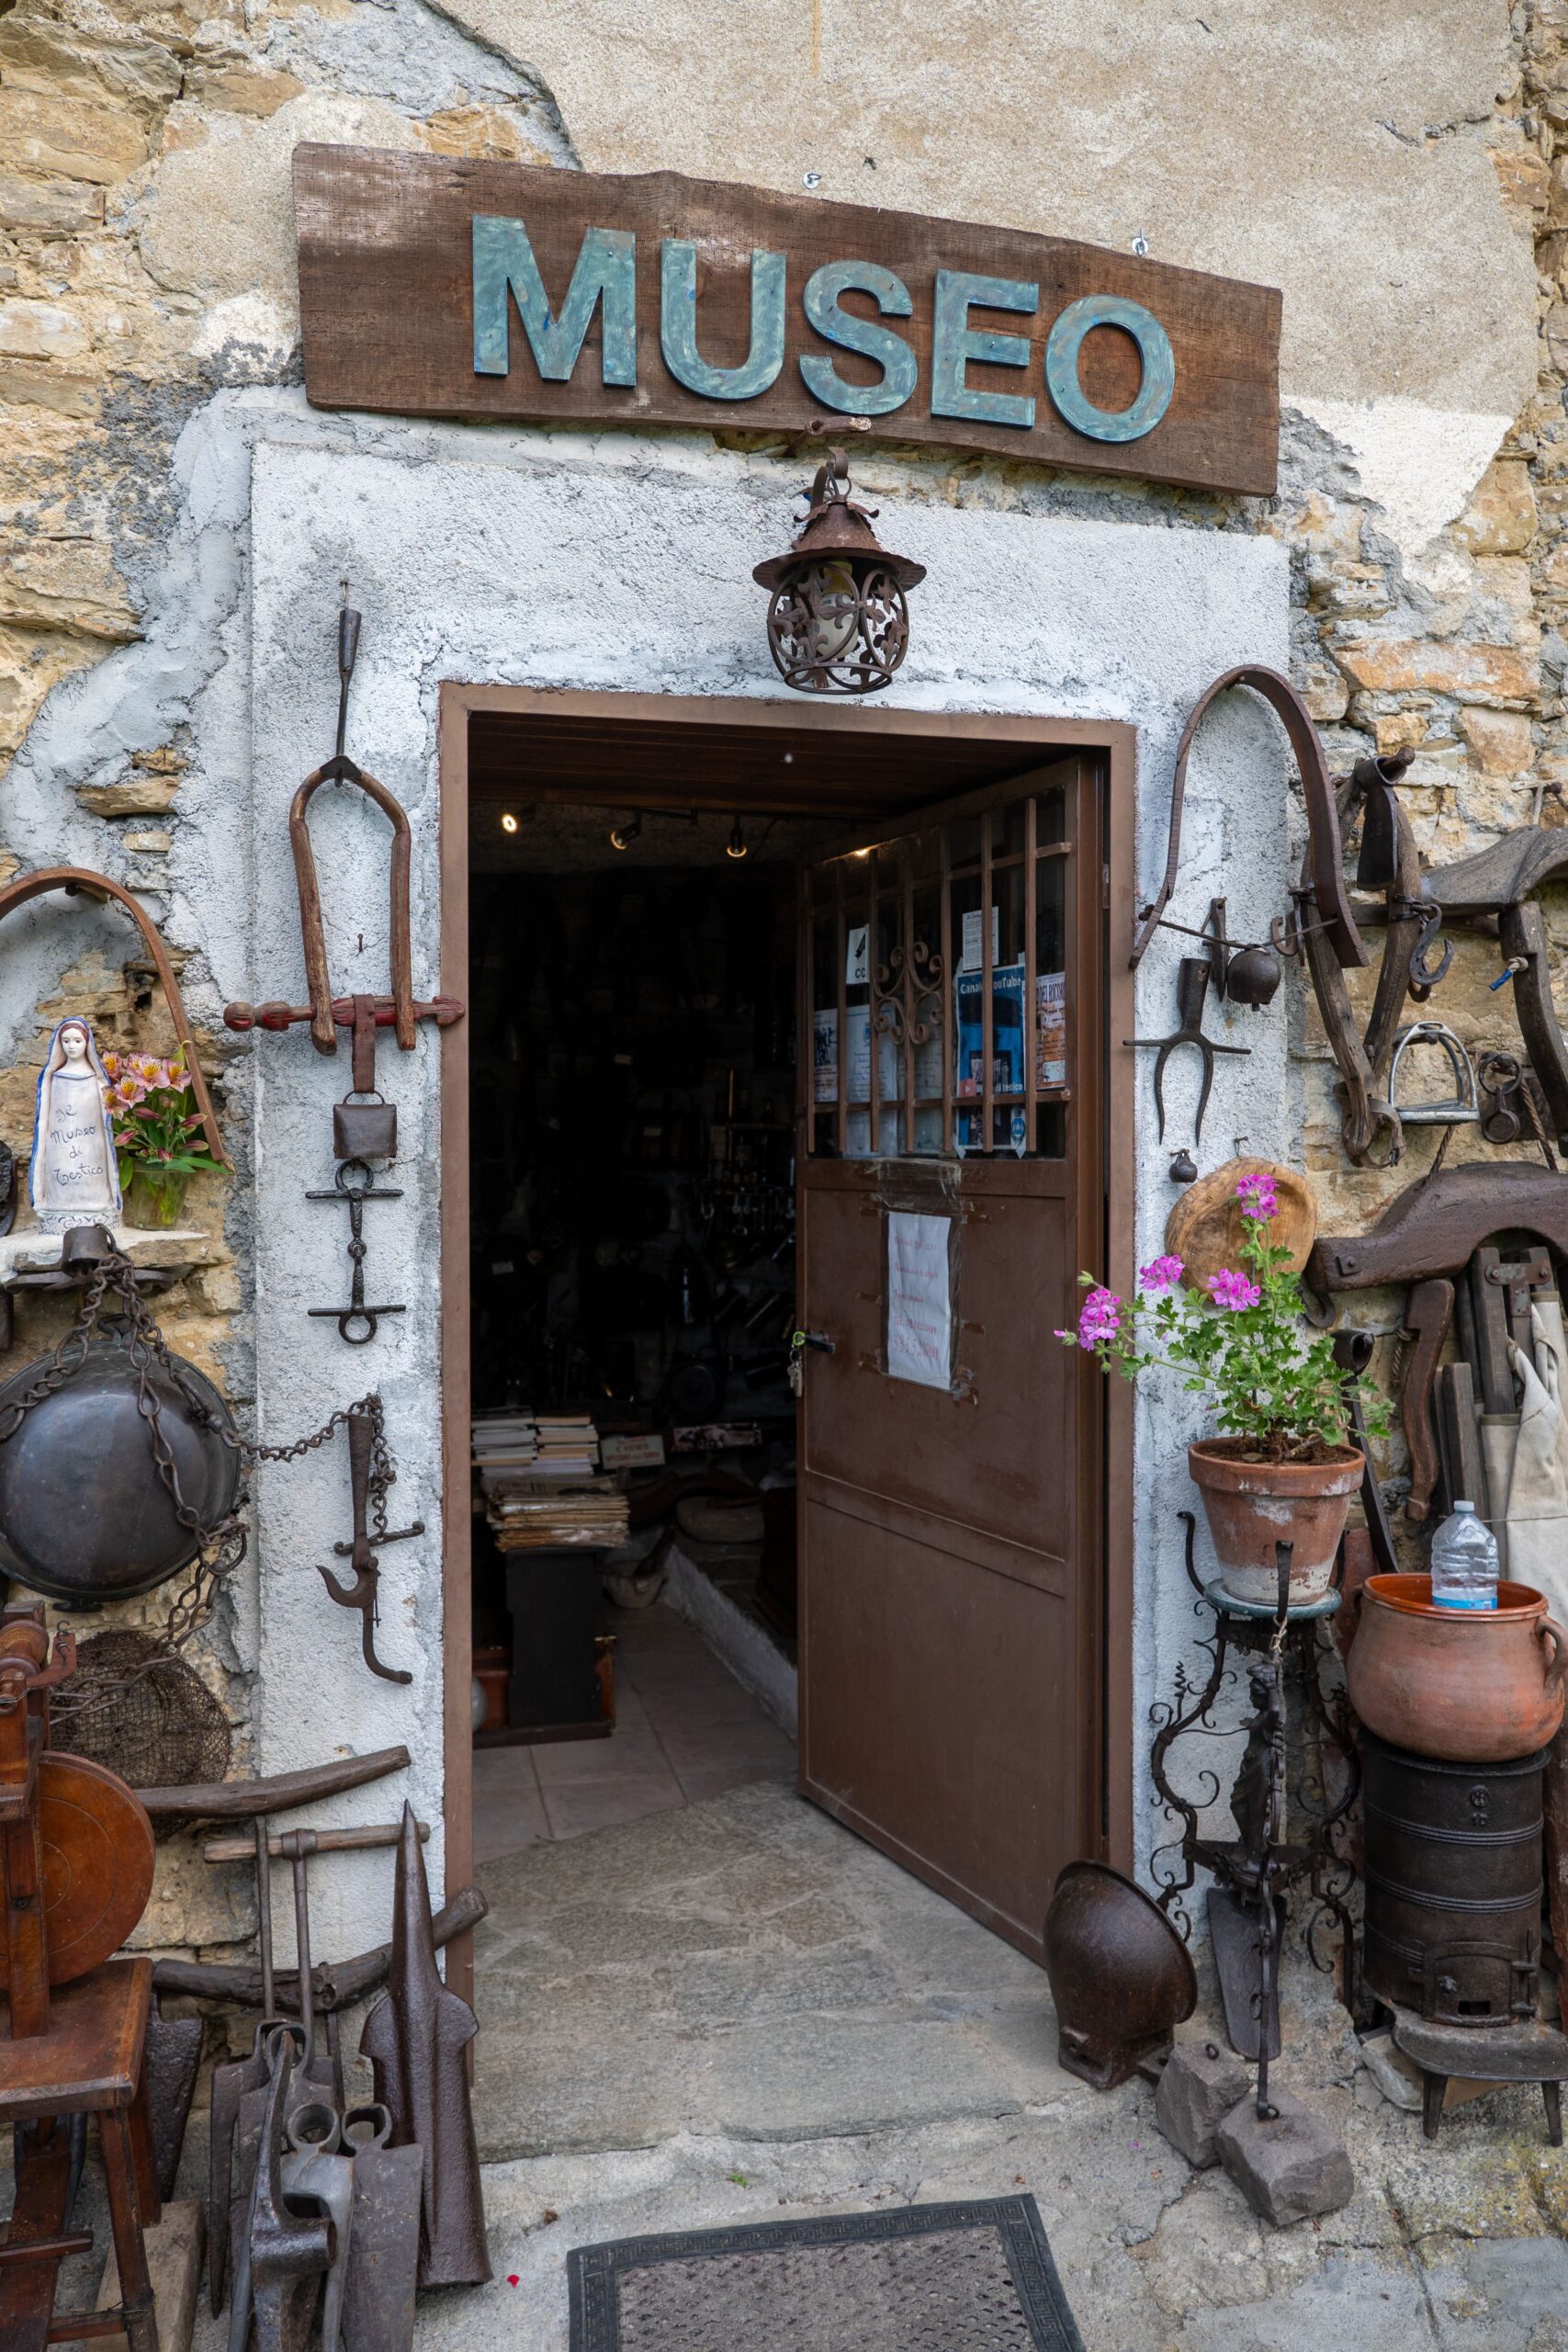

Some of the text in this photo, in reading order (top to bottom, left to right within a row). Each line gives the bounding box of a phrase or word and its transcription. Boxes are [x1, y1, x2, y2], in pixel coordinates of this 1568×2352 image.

[472, 214, 1175, 443] MUSEO
[960, 980, 983, 995] Canal
[991, 975, 1021, 990] ouTube
[51, 1125, 96, 1145] Museo
[69, 1145, 84, 1159] di
[52, 1162, 103, 1186] Testico
